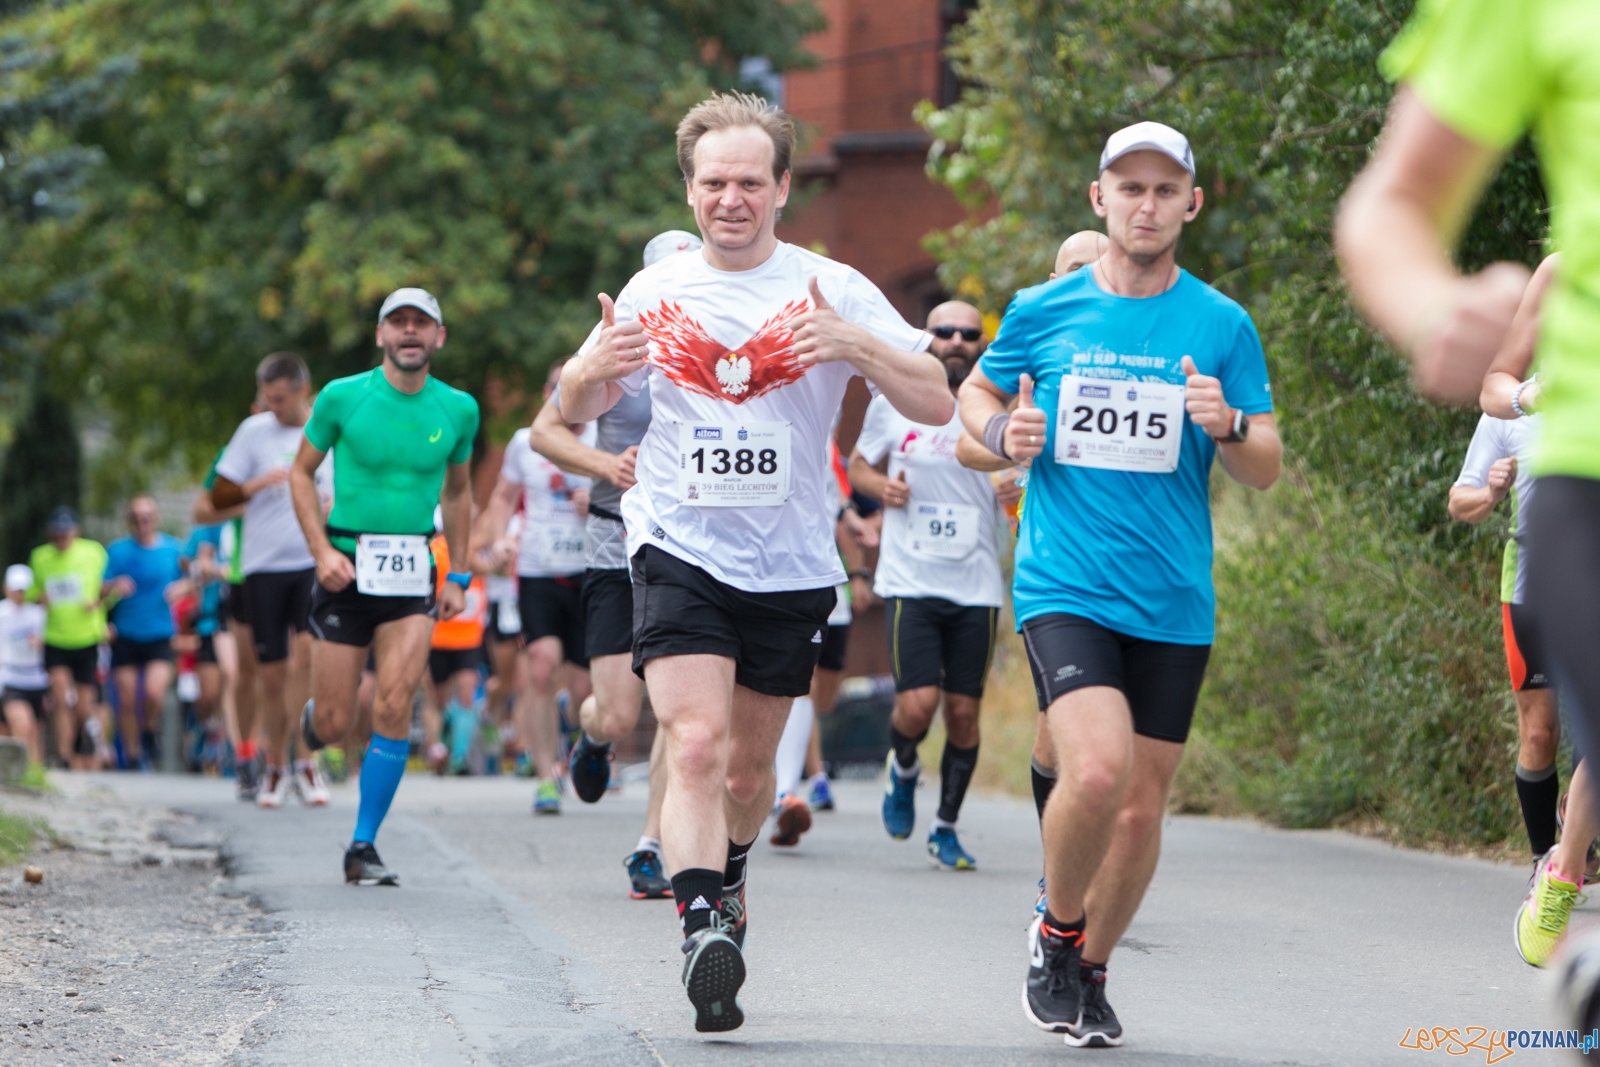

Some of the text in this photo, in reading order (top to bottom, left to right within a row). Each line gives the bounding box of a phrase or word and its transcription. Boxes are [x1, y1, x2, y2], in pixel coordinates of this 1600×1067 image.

[1071, 405, 1167, 439] 2015
[691, 447, 778, 475] 1388
[737, 482, 778, 491] LECHITÓW
[929, 520, 956, 537] 95
[375, 554, 415, 572] 781
